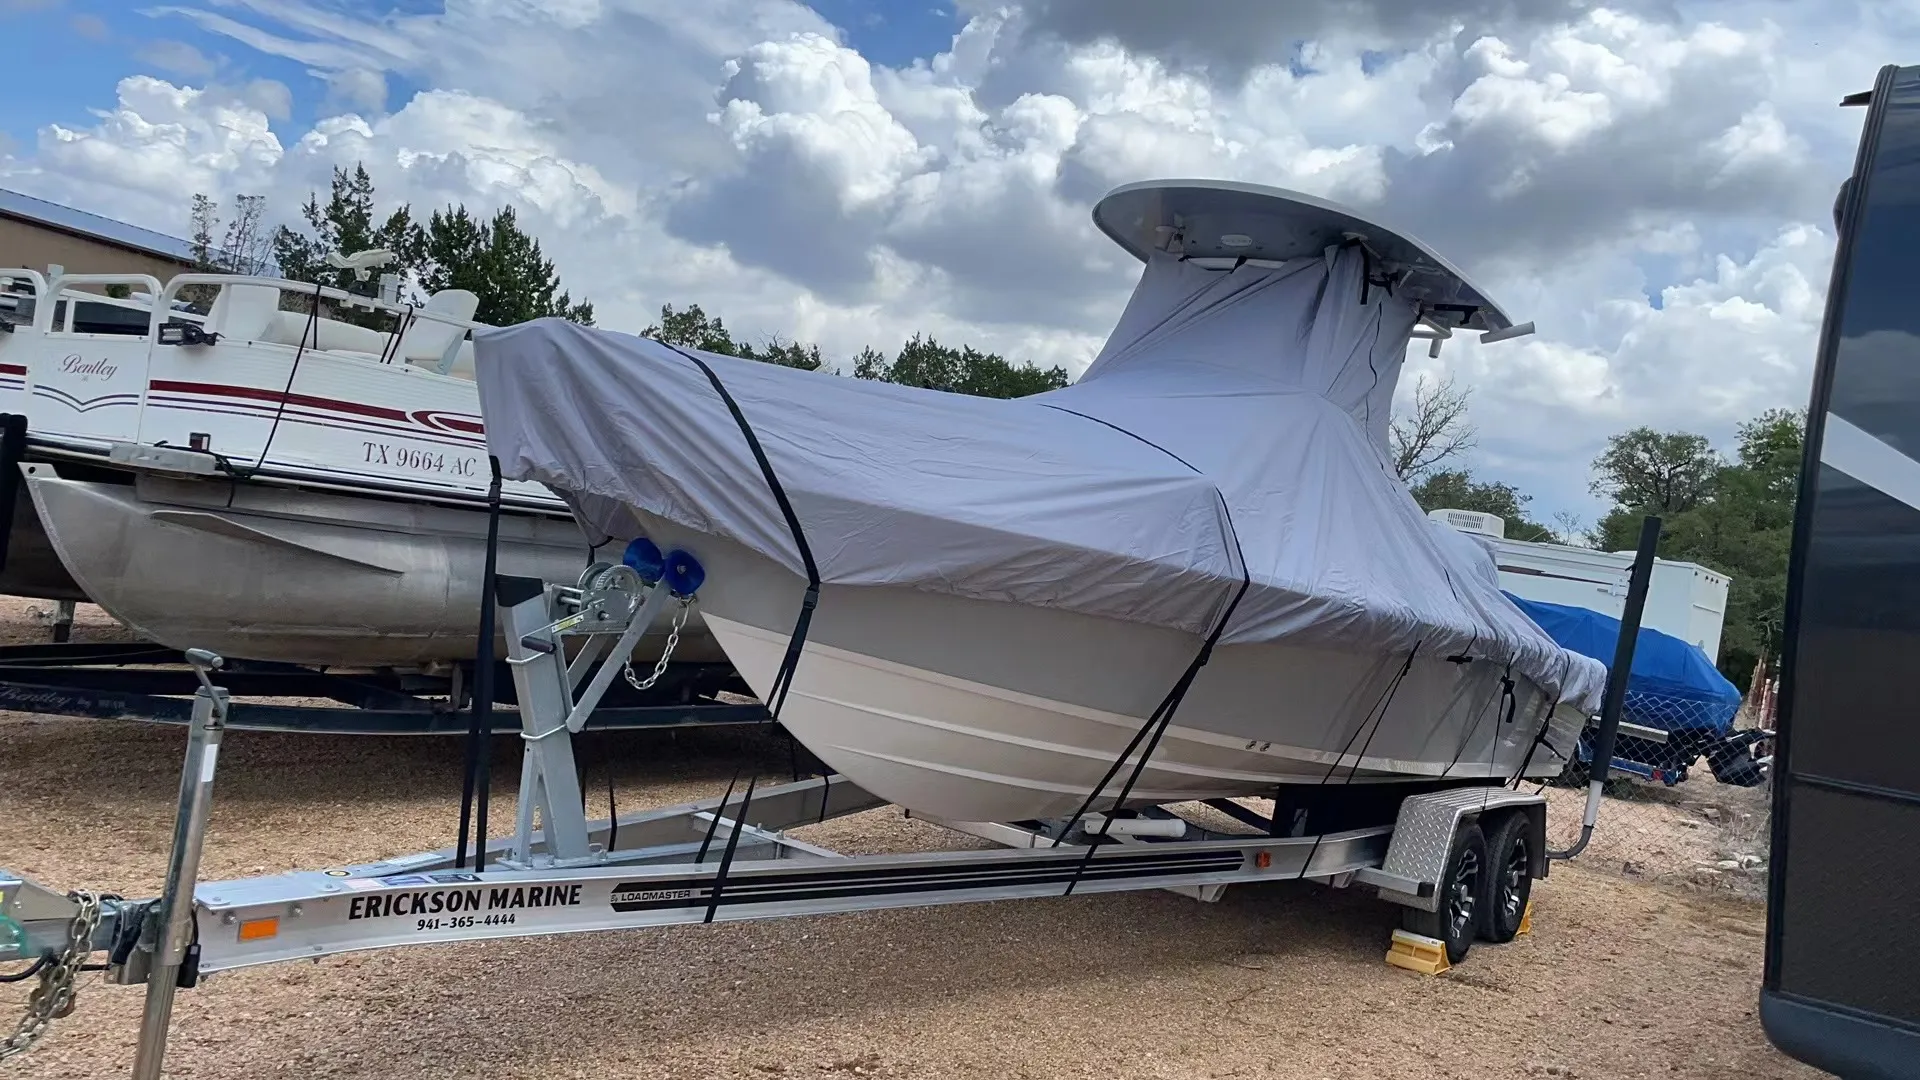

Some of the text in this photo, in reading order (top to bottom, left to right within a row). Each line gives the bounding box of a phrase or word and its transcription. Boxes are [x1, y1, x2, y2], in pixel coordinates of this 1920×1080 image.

[63, 353, 118, 382] Bentley
[363, 441, 477, 477] TX 9664 AC
[348, 884, 583, 920] ERICKSON MARINE
[621, 890, 691, 902] LOADMASTER
[417, 913, 516, 931] 941-365-4444
